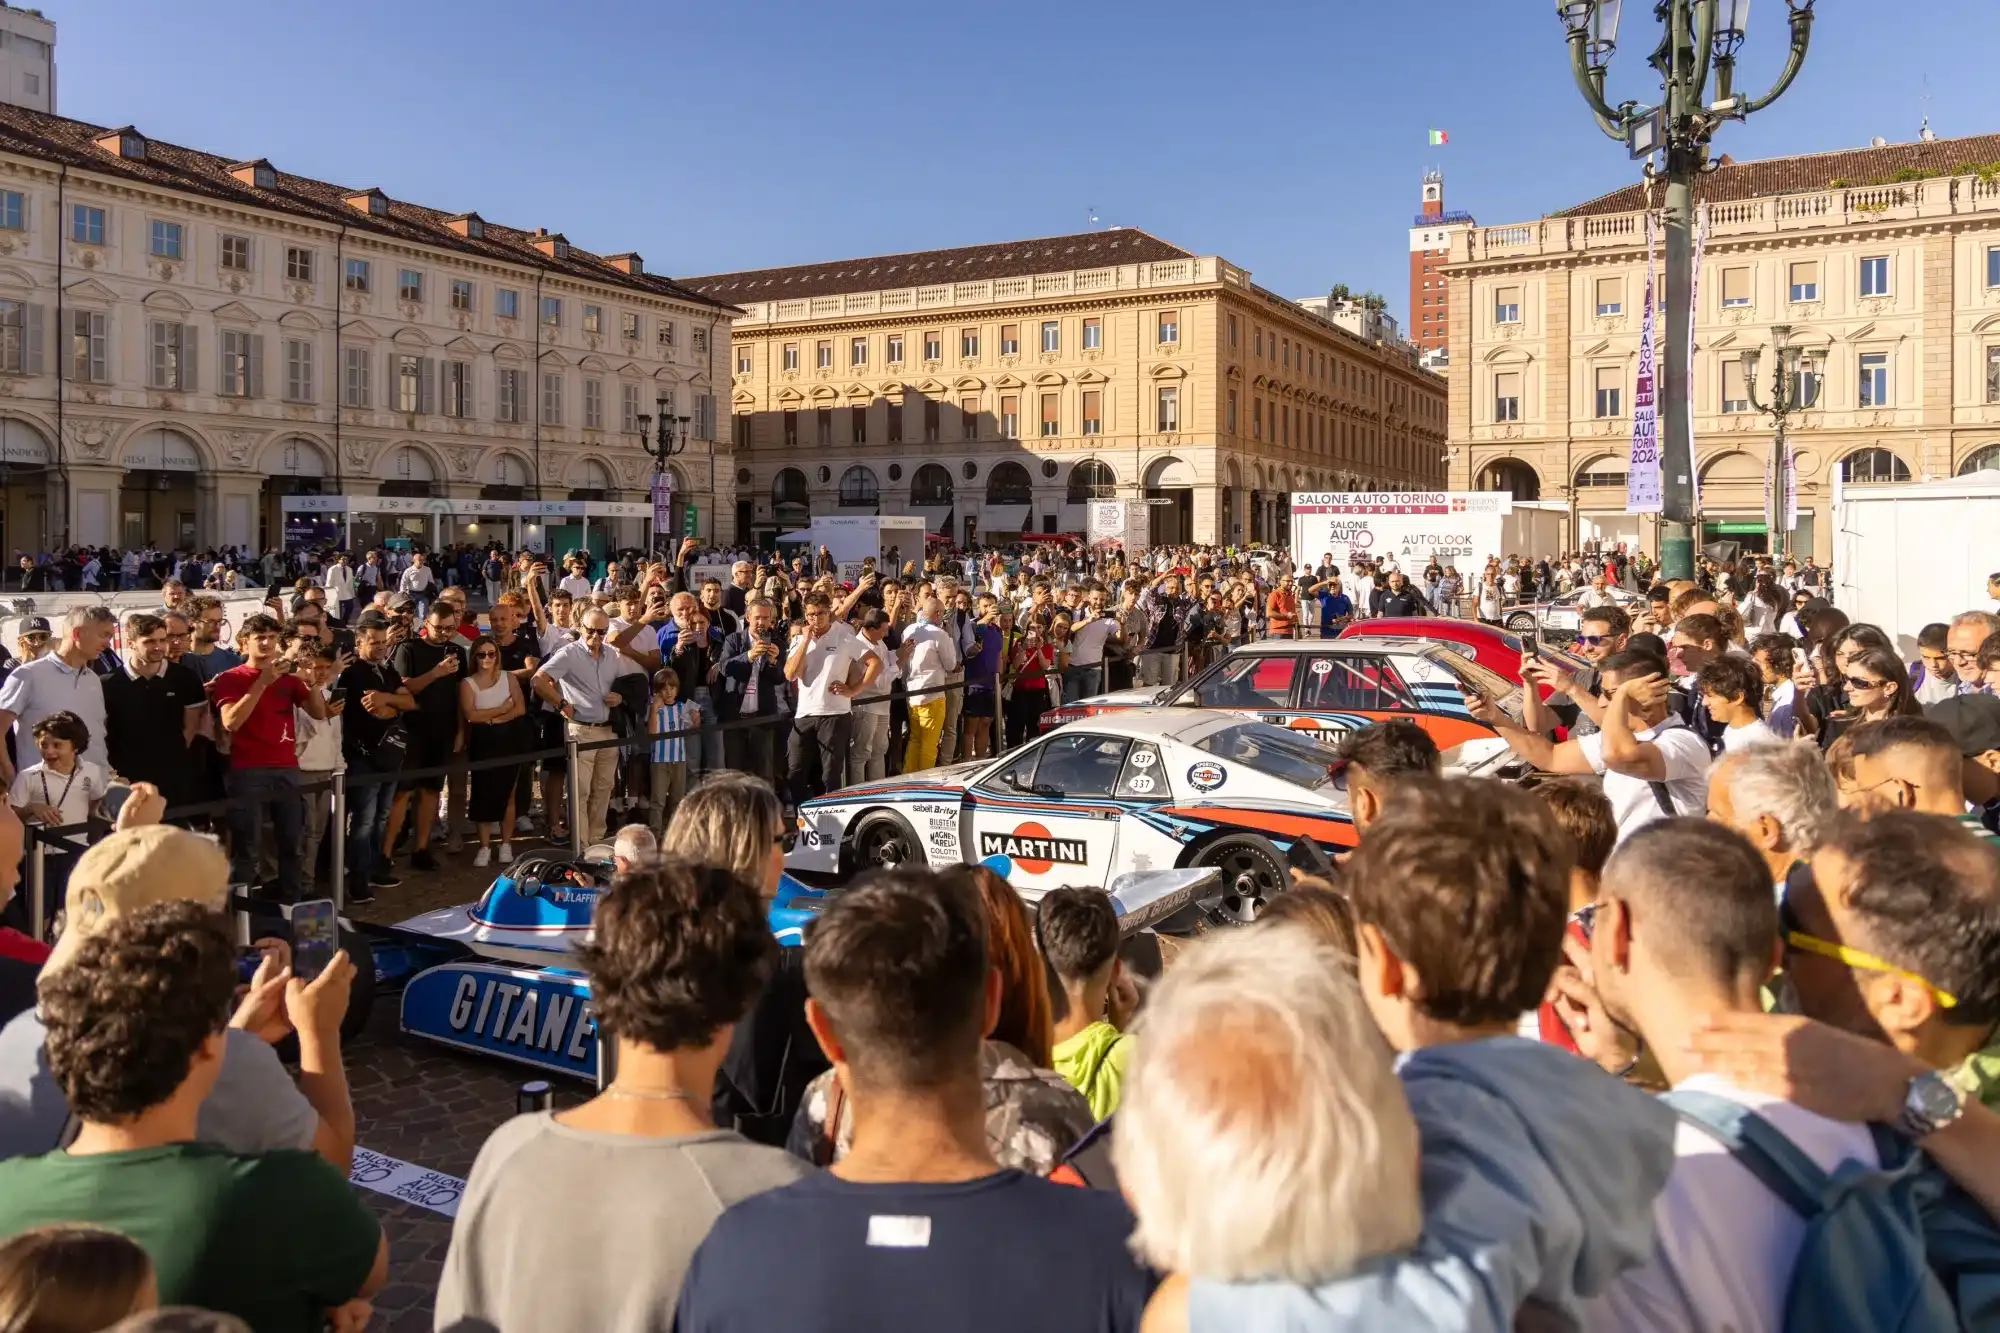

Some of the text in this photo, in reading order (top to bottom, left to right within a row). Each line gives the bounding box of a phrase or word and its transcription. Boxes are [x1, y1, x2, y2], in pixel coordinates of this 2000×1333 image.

[1298, 493, 1446, 504] SALONE AUTO TORINO
[1315, 506, 1427, 514] INFOPOINT
[1330, 521, 1369, 529] SALONE
[1330, 530, 1374, 548] AUTO
[1402, 534, 1473, 545] AUTOLOOK
[1315, 662, 1329, 671] 542
[1134, 754, 1152, 763] 537
[1194, 772, 1221, 780] MARTINI
[1133, 779, 1150, 788] 337
[929, 818, 957, 828] BILSTEIN
[802, 830, 819, 846] VS
[930, 847, 958, 856] COLOTTI
[984, 835, 1084, 862] MARTINI
[356, 1151, 404, 1170] SALONE
